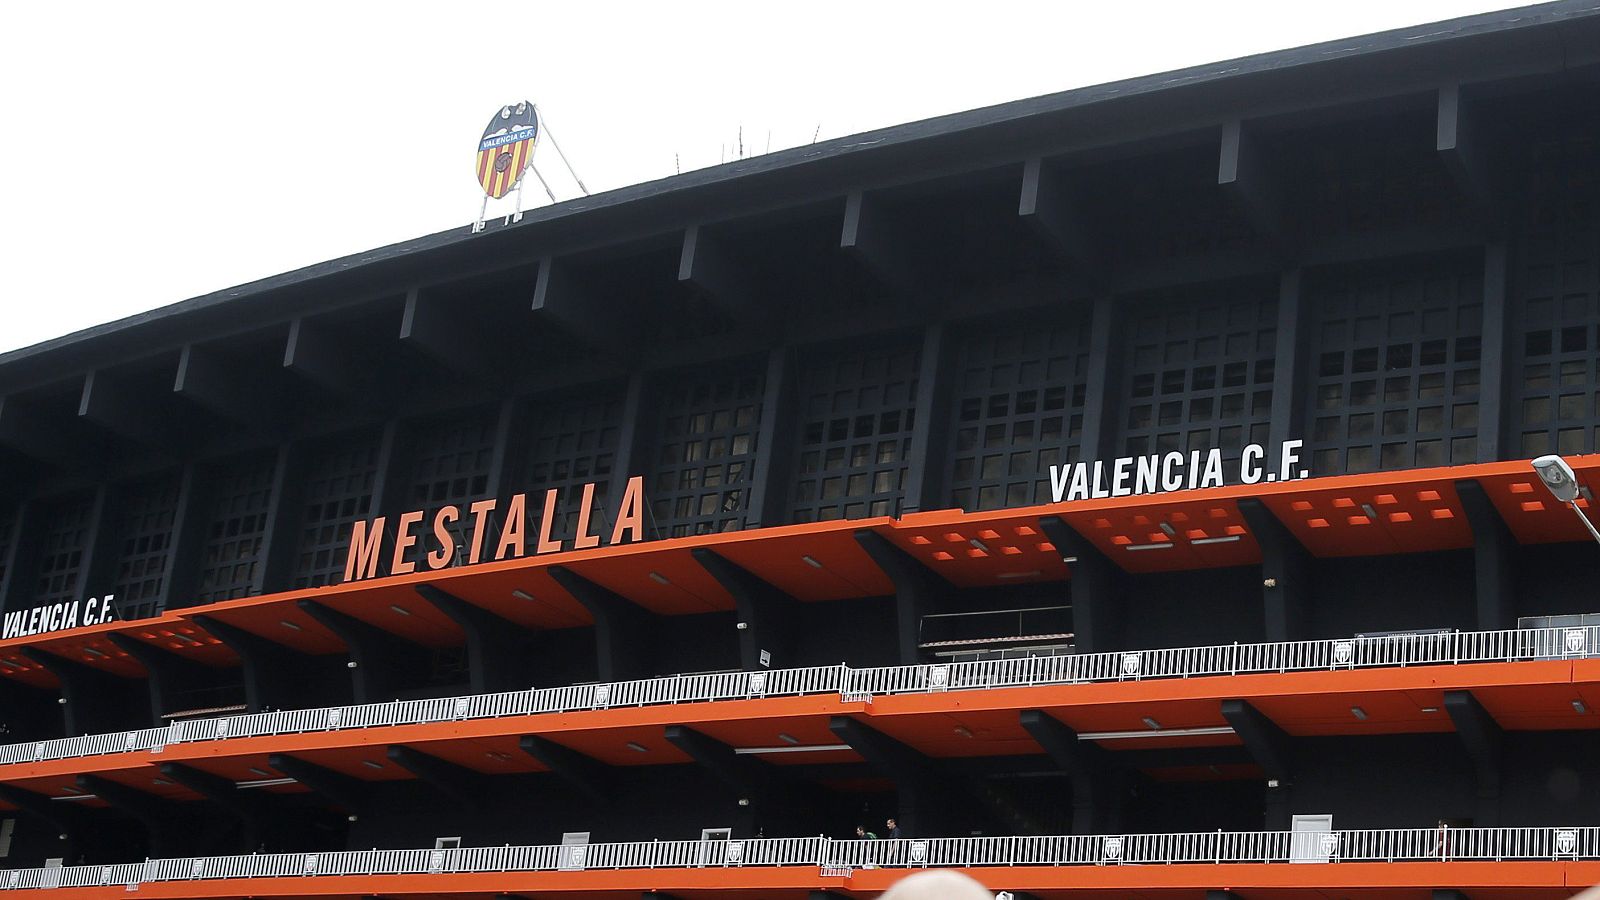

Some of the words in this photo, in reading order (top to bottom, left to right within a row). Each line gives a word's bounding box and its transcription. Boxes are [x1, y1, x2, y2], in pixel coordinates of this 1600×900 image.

[483, 133, 518, 148] VALENCIA
[1049, 448, 1224, 503] VALENCIA
[1240, 440, 1309, 484] C.F.
[343, 476, 643, 581] MESTALLA
[2, 600, 79, 640] VALENCIA
[83, 594, 115, 626] C.F.
